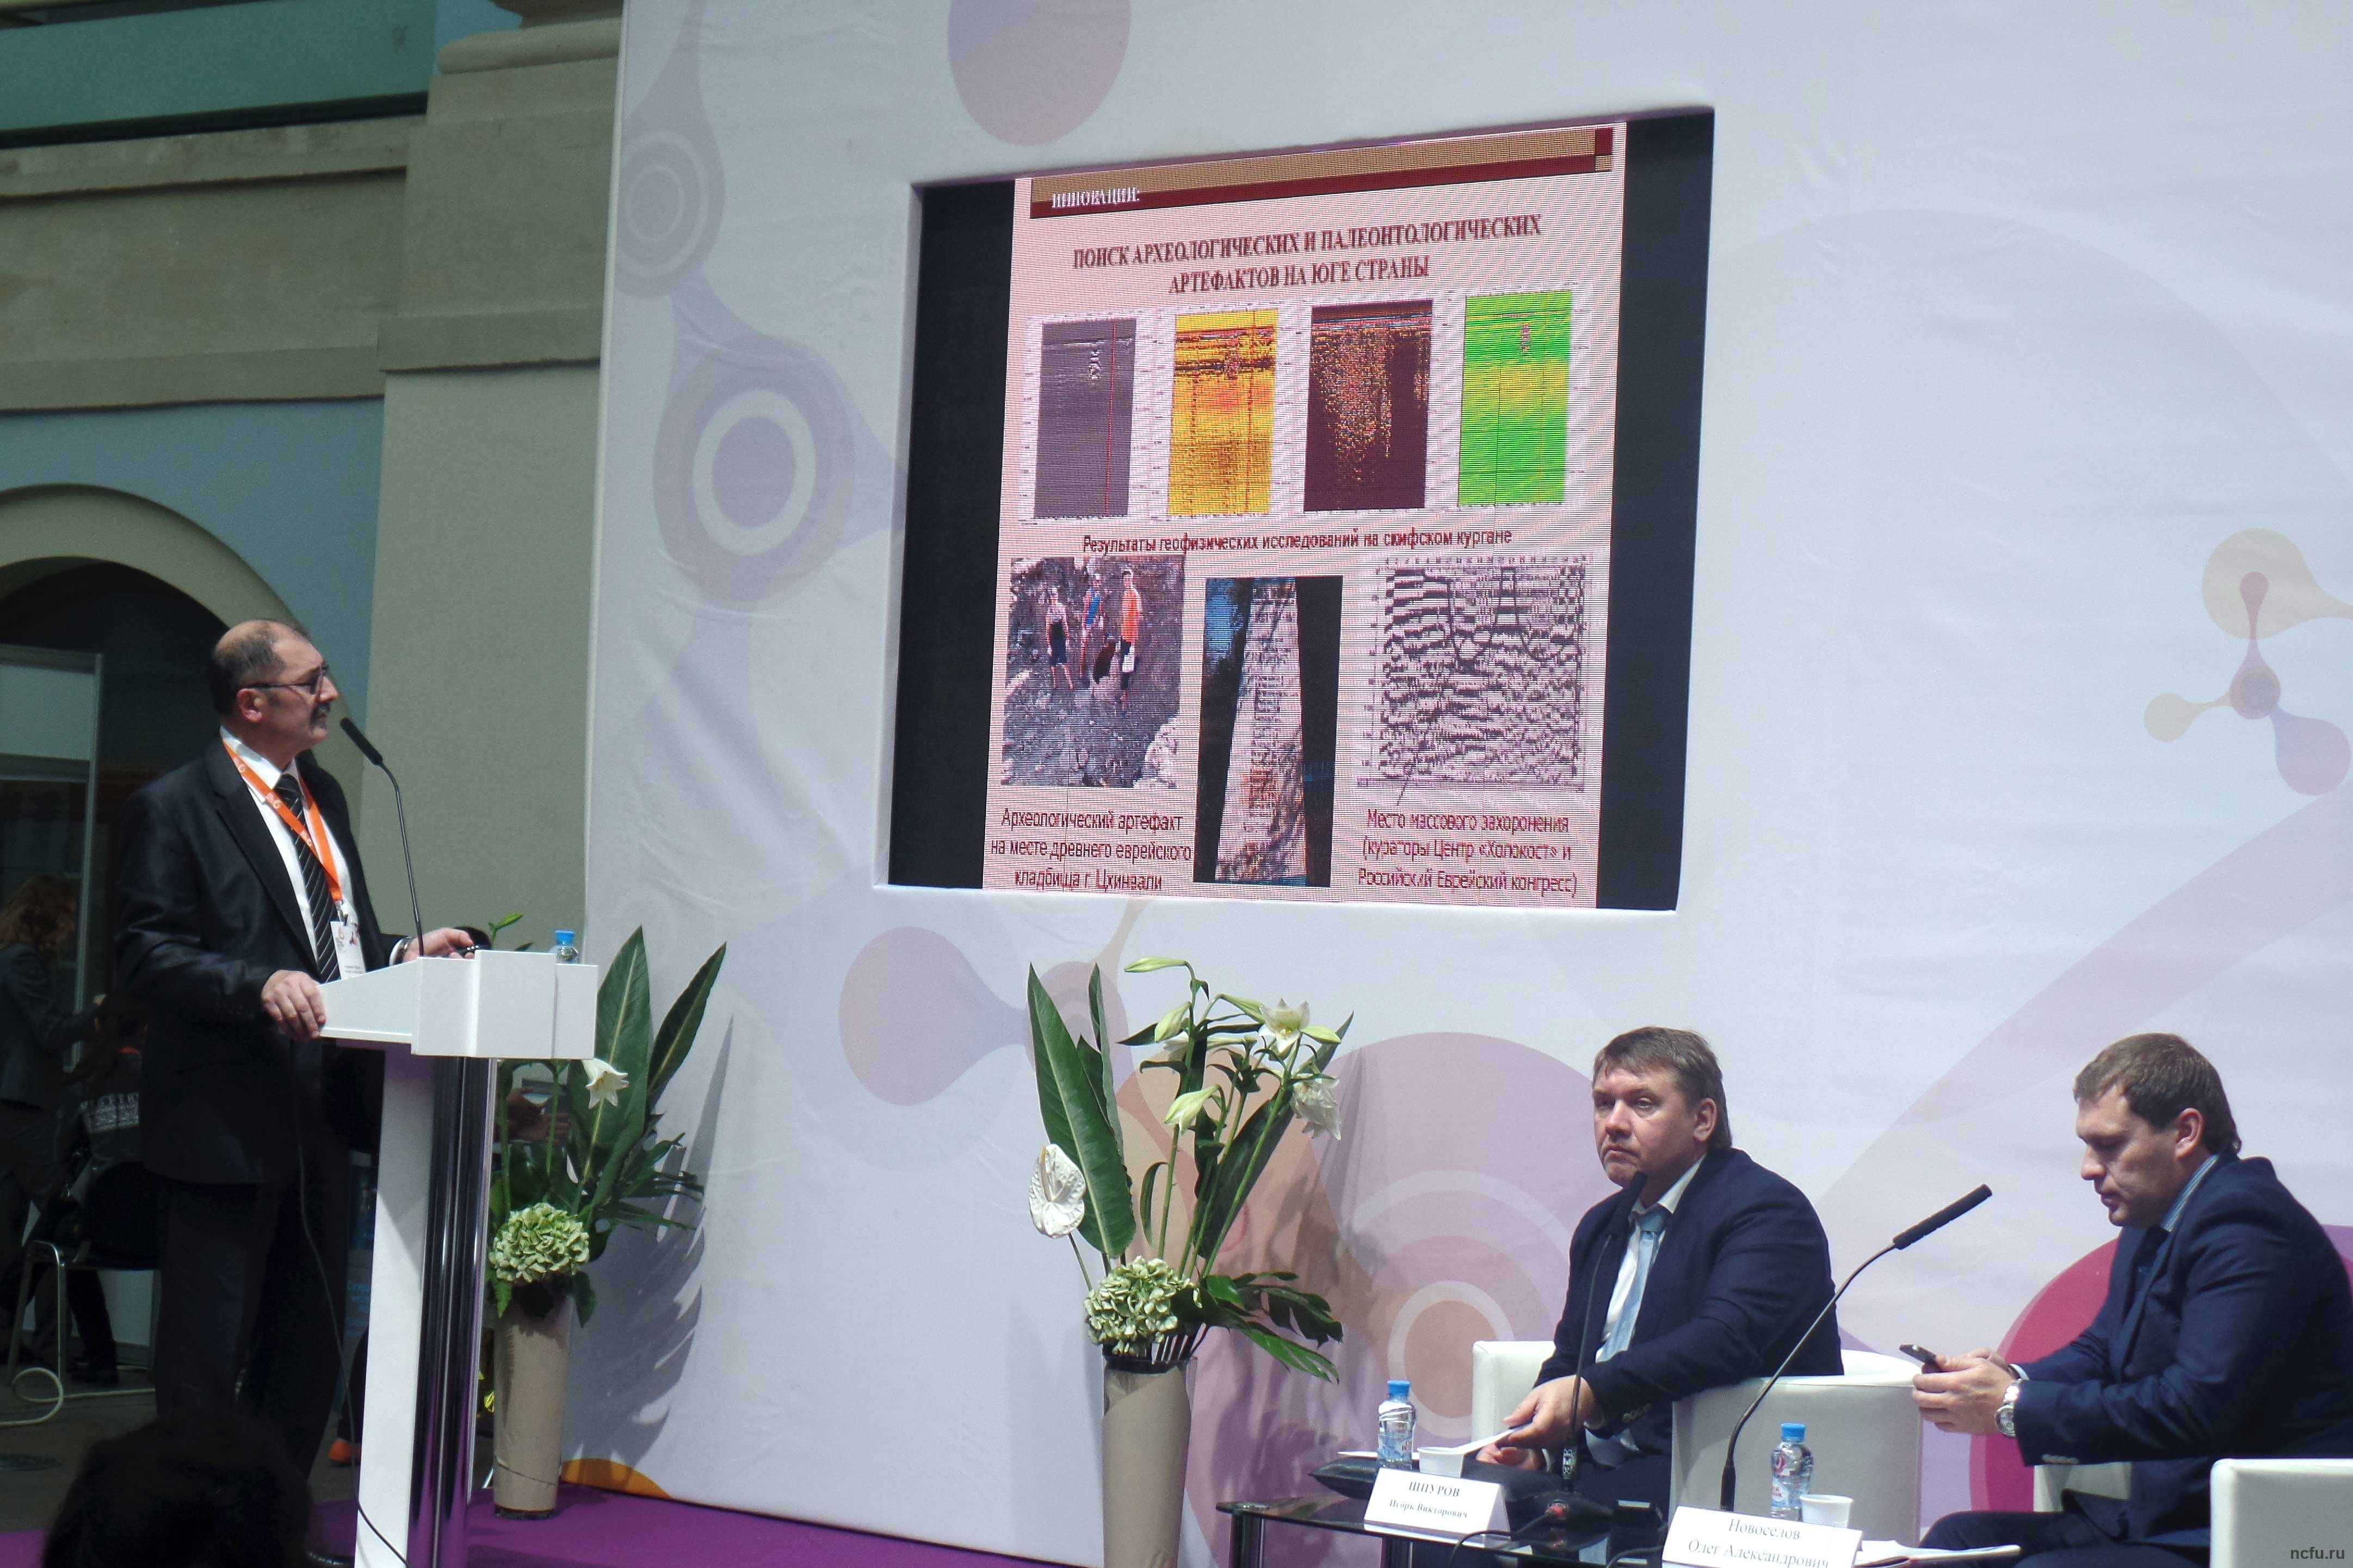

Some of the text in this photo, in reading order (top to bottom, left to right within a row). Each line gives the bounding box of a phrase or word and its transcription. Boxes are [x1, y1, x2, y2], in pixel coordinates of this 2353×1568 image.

[1072, 214, 1541, 269] ПОИСК АРХЕОЛОГИЧЕСКИХ И ПАЛЕОНТОЛОГИЧЕСКИХ
[1169, 255, 1430, 294] АРТЕФАКТОВ НА ЮГЕ СТРАНЫ
[1083, 526, 1512, 556] Результаты геофизических исследований на скифском кургане
[1001, 808, 1184, 835] Археологический артефакт
[1367, 809, 1570, 835] Место массового захоронения
[991, 839, 1193, 865] на месте древнего еврейского
[1434, 839, 1475, 863] Центр
[1562, 845, 1571, 860] и
[1015, 867, 1080, 891] кладбища
[1358, 867, 1578, 898] Российский Еврейский конгресс)
[1389, 1499, 1468, 1518] Игорь Викторович
[1728, 1518, 1800, 1540] Новоселов
[1688, 1538, 1829, 1568] Олег Александрович
